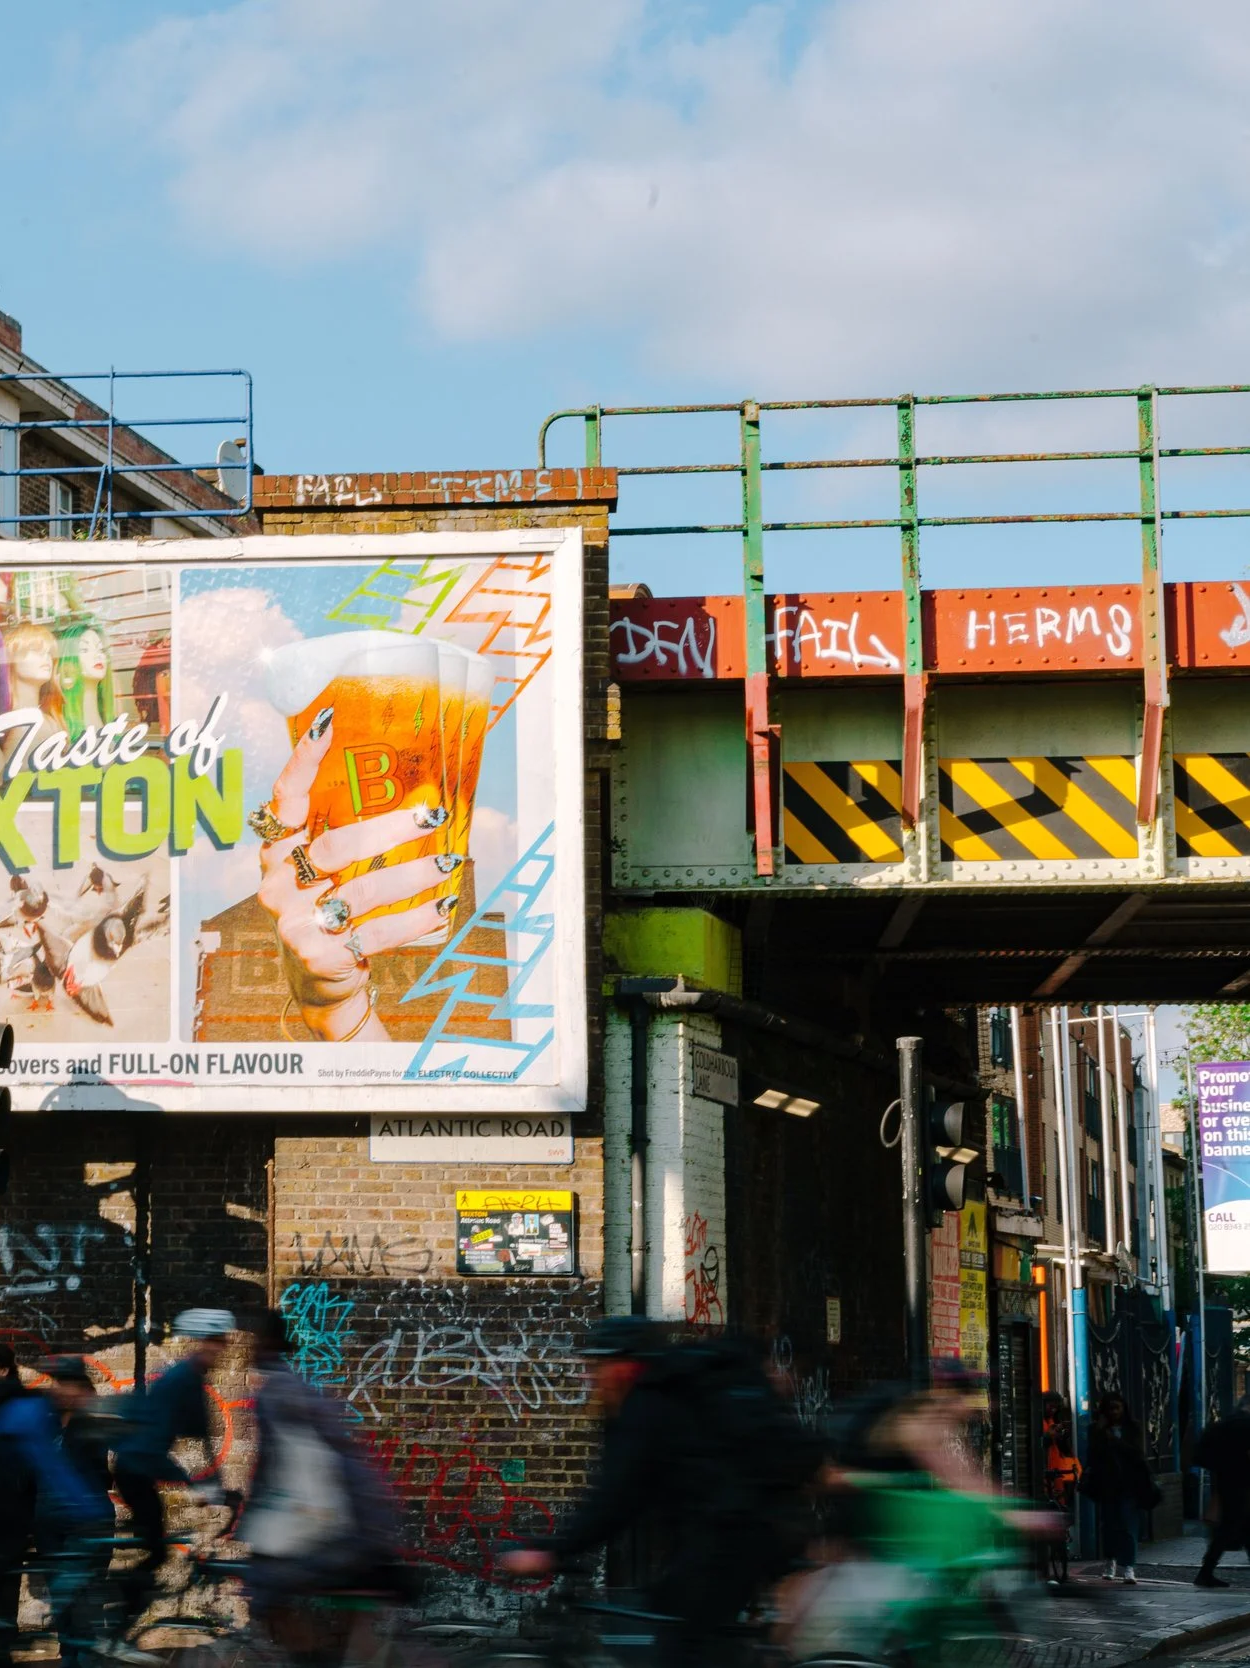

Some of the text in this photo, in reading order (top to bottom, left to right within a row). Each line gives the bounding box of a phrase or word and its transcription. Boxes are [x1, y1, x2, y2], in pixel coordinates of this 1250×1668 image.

[166, 690, 230, 778] of
[65, 1053, 101, 1075] and
[109, 1053, 199, 1075] FULL-ON
[206, 1053, 304, 1075] FLAVOUR
[463, 1070, 519, 1080] COLLECTIVE
[1199, 1070, 1250, 1084] Promo
[1200, 1085, 1236, 1100] your
[379, 1119, 565, 1138] ATLANTIC ROAD
[1202, 1116, 1219, 1128] or
[1203, 1131, 1223, 1142] on
[1208, 1212, 1236, 1223] CALL
